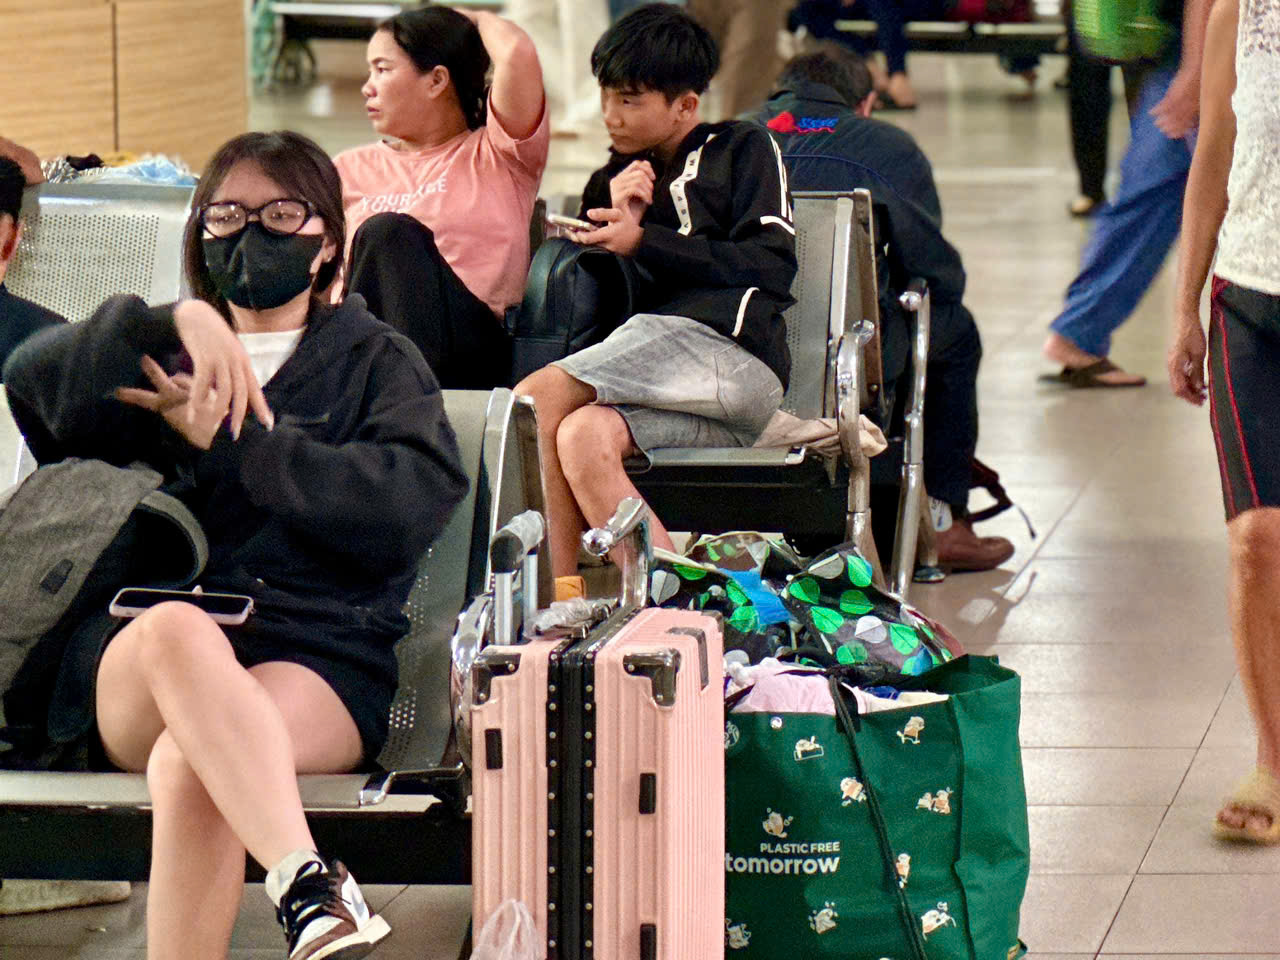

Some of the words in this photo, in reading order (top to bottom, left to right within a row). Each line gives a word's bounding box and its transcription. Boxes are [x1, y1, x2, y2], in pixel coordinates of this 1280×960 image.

[760, 842, 809, 854] PLASTIC
[810, 841, 840, 853] FREE
[725, 852, 840, 874] tomorrow
